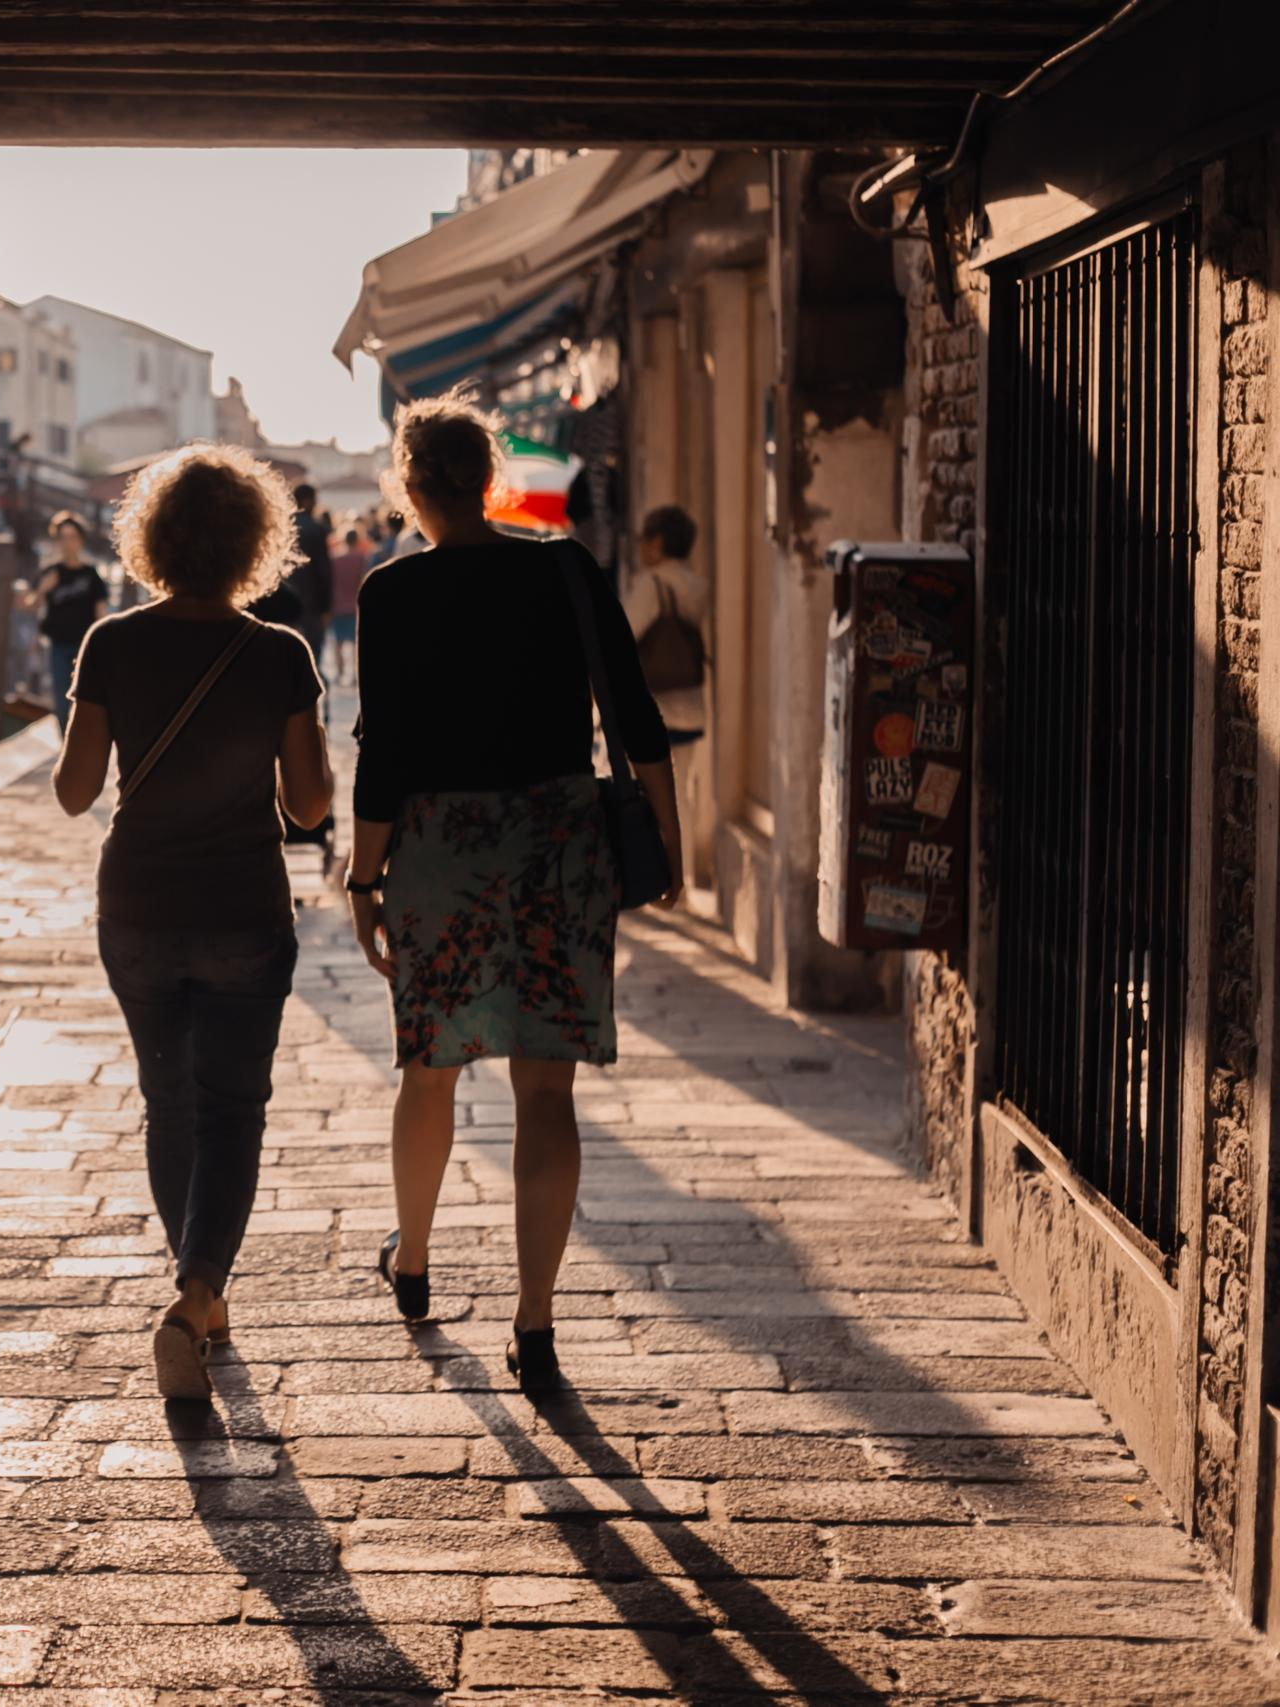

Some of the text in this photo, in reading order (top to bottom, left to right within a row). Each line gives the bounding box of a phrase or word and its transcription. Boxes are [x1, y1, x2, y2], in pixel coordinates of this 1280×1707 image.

[921, 732, 955, 747] MOB
[866, 758, 912, 778] PULS
[867, 779, 911, 799] LAZY
[906, 841, 953, 865] ROZ
